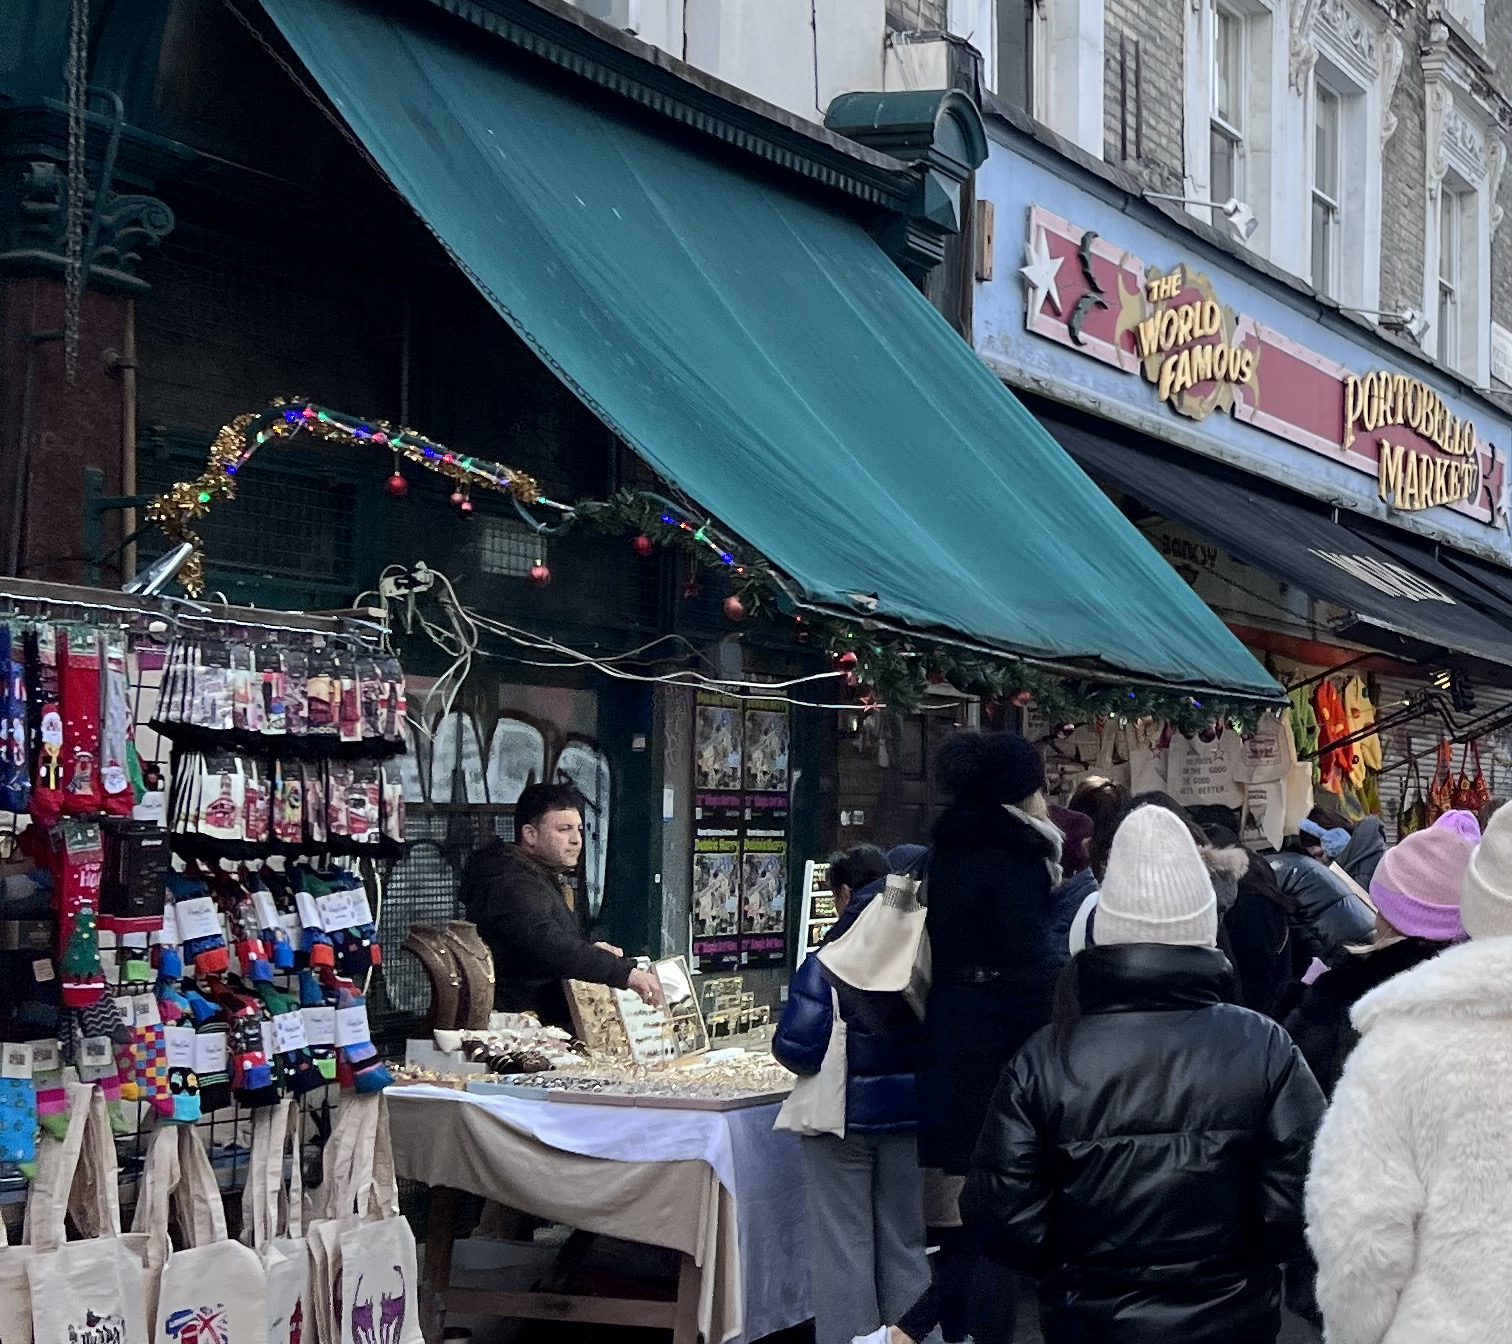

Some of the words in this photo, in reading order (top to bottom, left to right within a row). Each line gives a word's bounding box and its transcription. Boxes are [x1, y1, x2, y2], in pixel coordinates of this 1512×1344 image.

[1150, 273, 1182, 302] THE
[1138, 301, 1221, 357] WORLD
[1159, 343, 1253, 402] FAMOUS
[1343, 370, 1477, 456] PORTOBELLO
[1378, 438, 1476, 511] MARKET
